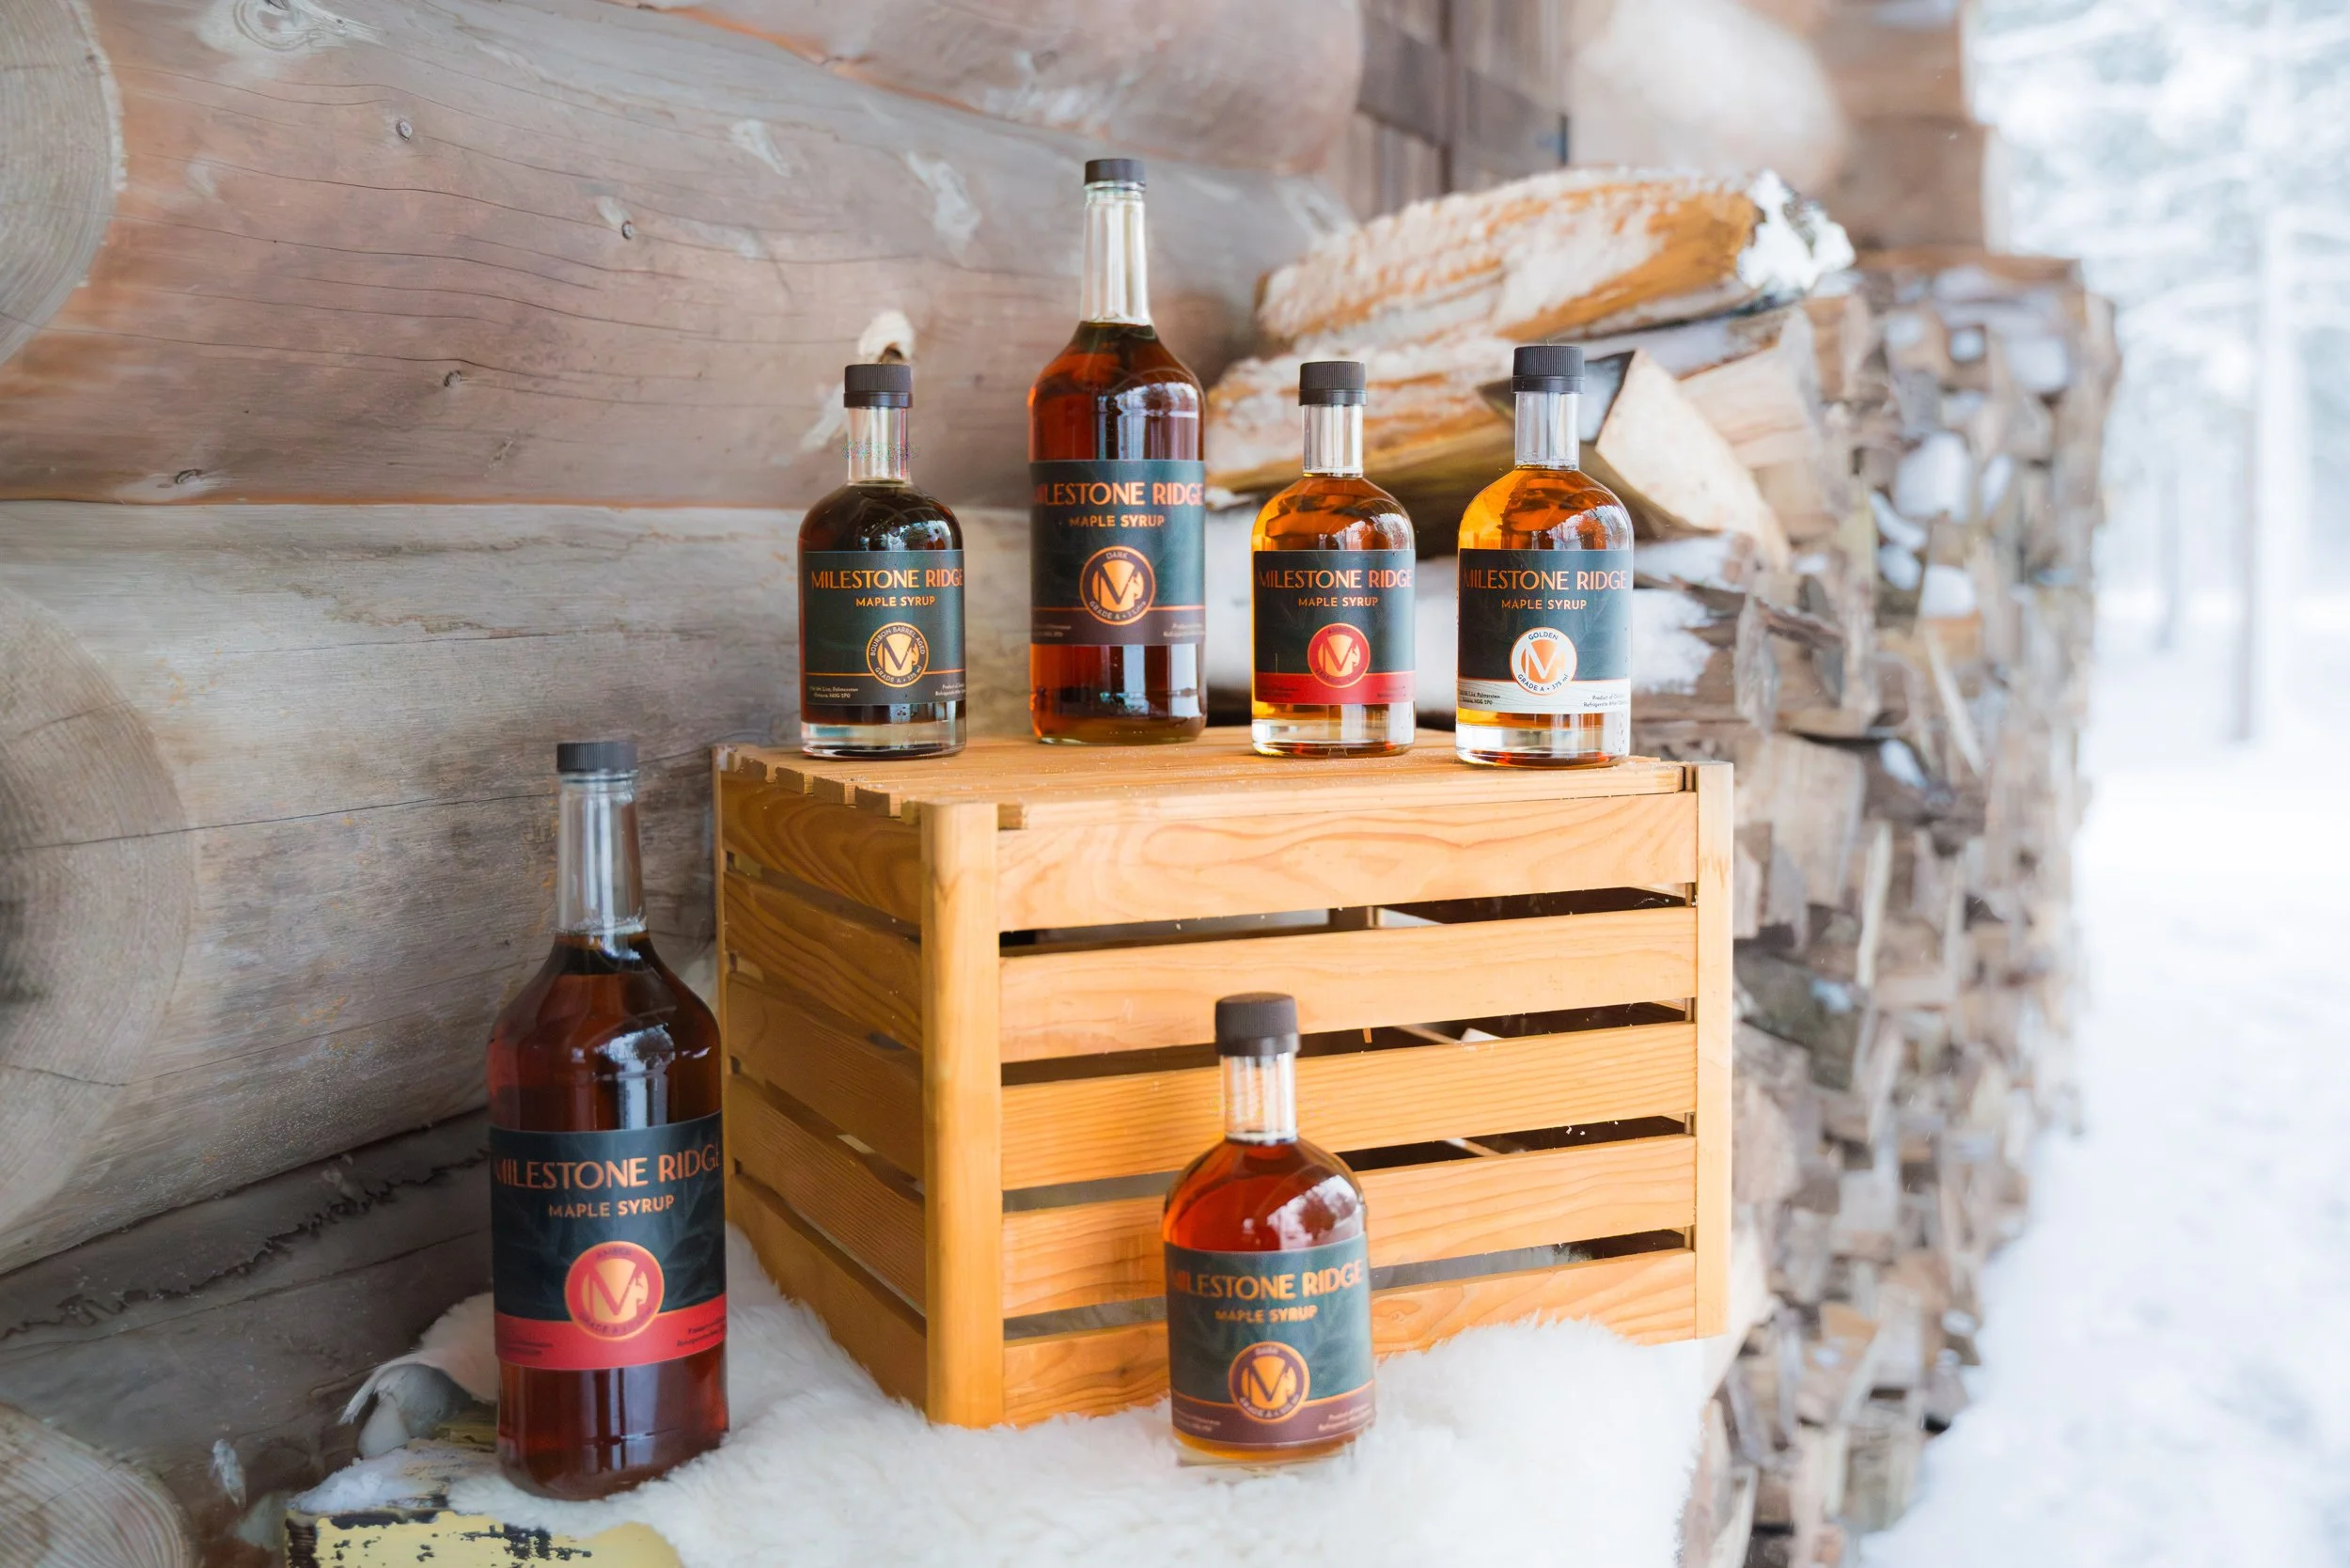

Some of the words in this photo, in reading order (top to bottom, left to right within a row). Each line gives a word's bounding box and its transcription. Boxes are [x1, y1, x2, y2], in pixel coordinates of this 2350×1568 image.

[1152, 481, 1204, 506] RIDGE
[1069, 514, 1116, 527] MAPLE
[1120, 514, 1166, 527] SYRUP
[1105, 551, 1129, 560] DARK
[810, 570, 920, 589] MILESTONE
[925, 568, 964, 588] RIDGE
[1260, 569, 1362, 588] MILESTONE
[1368, 569, 1413, 588] RIDGE
[1464, 569, 1570, 590] MILESTONE
[1576, 570, 1627, 590] RIDGE
[855, 596, 897, 607] MAPLE
[900, 595, 936, 607] SYRUP
[1298, 597, 1338, 607] MAPLE
[1341, 597, 1379, 607] SYRUP
[1501, 599, 1543, 610] MAPLE
[1547, 599, 1588, 610] SYRUP
[870, 627, 892, 656] BOURBON
[892, 625, 916, 638] BARREL
[915, 636, 926, 655] AGED
[1528, 631, 1559, 641] GOLDEN
[874, 666, 895, 683] GRADE
[1517, 673, 1539, 692] GRADE
[548, 1201, 610, 1218] MAPLE
[617, 1194, 675, 1216] SYRUP
[1302, 1260, 1363, 1297] RIDGE
[1214, 1309, 1264, 1324] MAPLE
[1269, 1305, 1319, 1324] SYRUP
